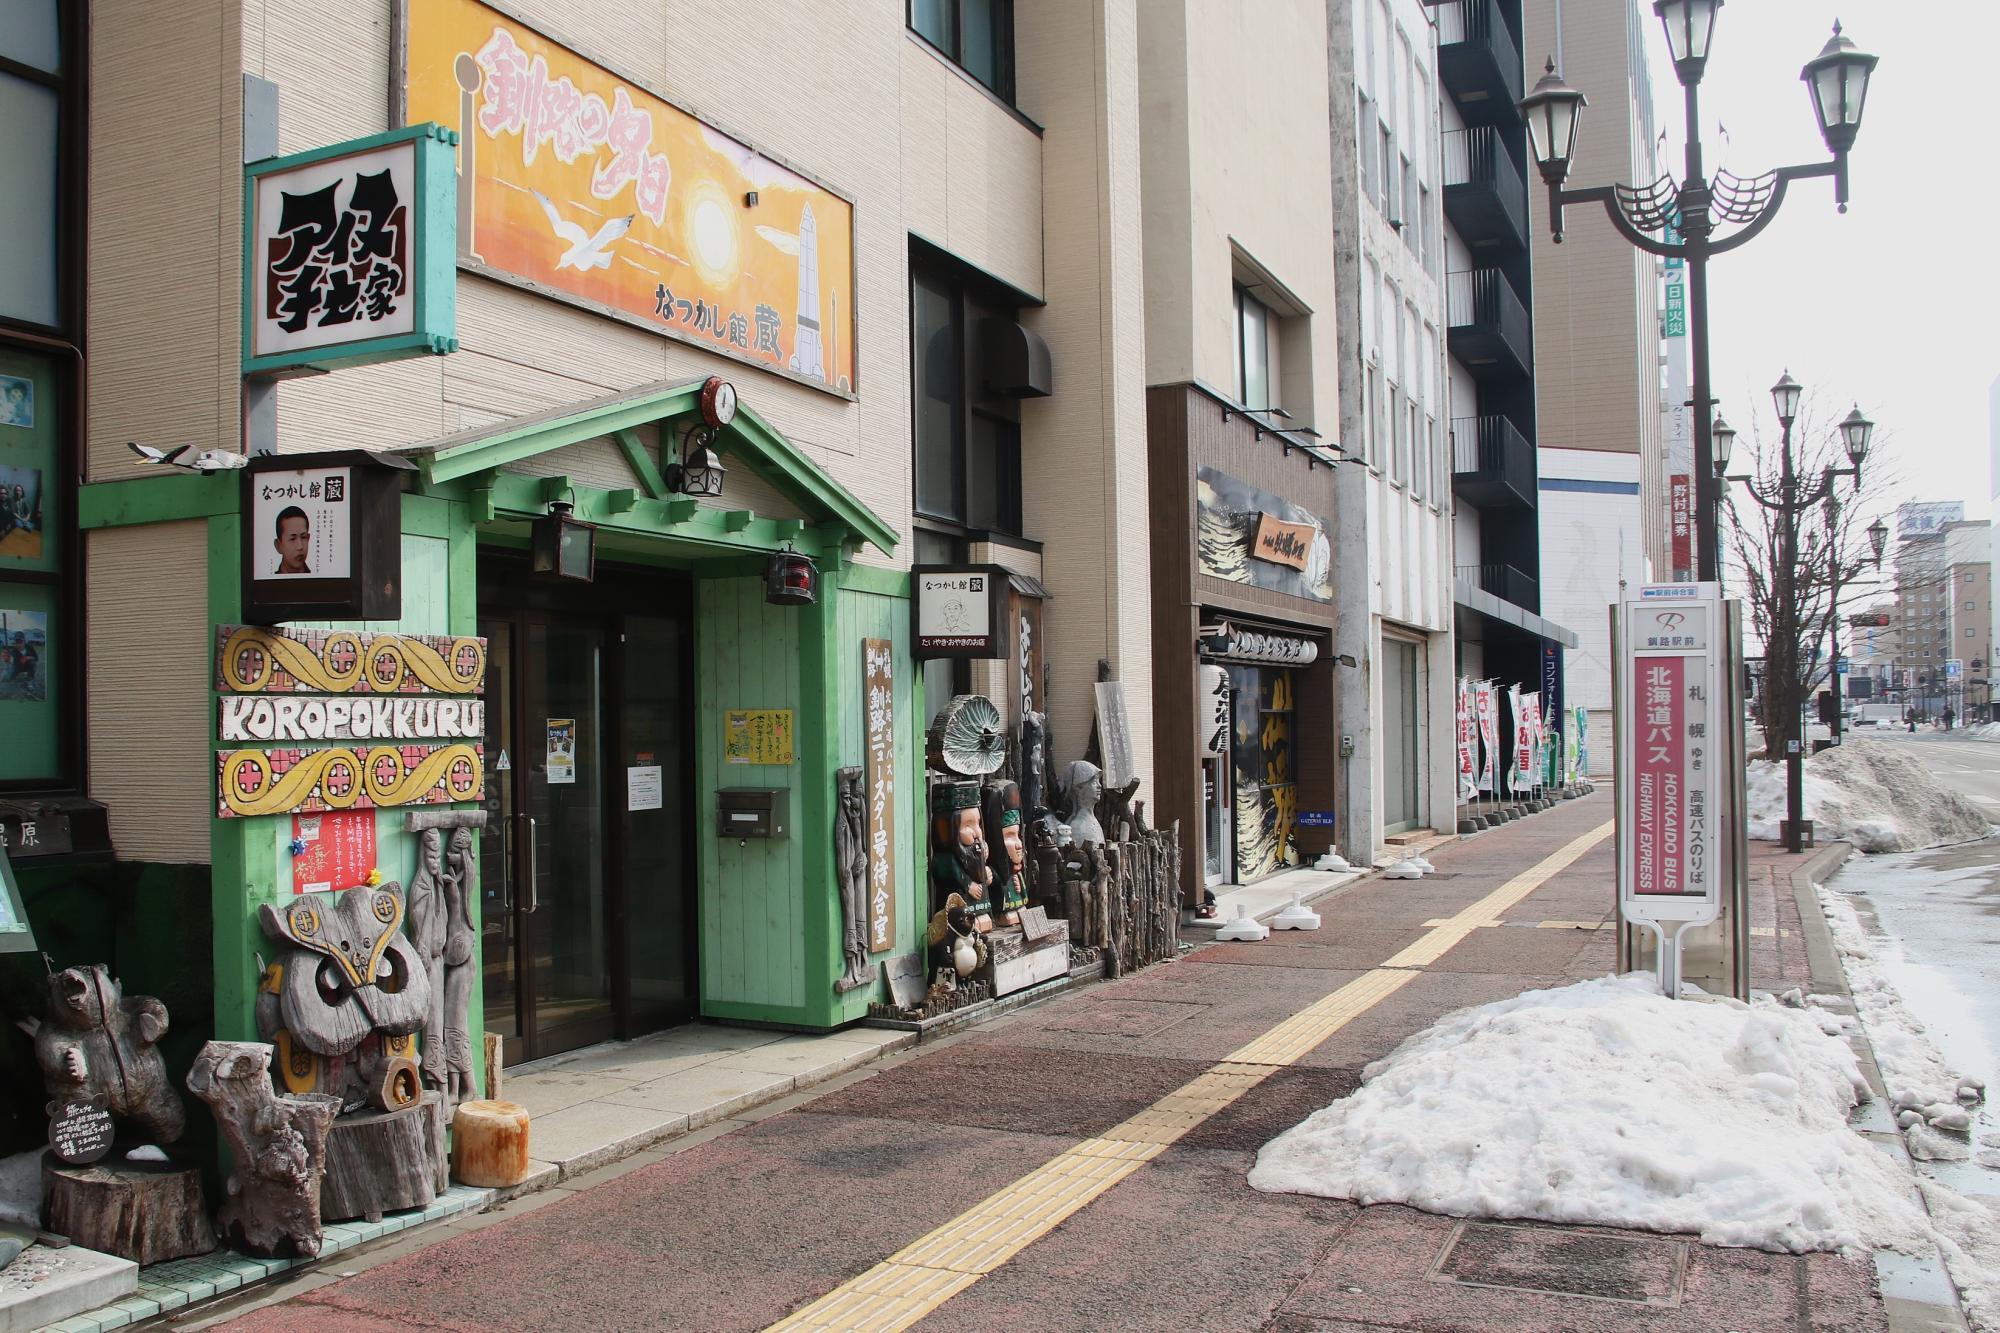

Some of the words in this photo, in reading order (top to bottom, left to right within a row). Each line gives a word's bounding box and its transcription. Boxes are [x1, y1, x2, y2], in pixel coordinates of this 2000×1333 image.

[1668, 286, 1682, 335] 日新火災
[262, 481, 322, 501] なつかし館
[326, 478, 343, 501] 蔵
[925, 580, 968, 591] なつかし館
[1647, 636, 1695, 647] 釧路駅前
[220, 696, 483, 741] KOROPOKKURU
[1646, 666, 1673, 764] 北海道バス
[1688, 685, 1705, 770] 札幌ゆき
[869, 685, 889, 945] 釧路ニュースター号待合室
[1640, 772, 1653, 831] HIGHWAY
[1664, 773, 1677, 854] HOKKAIDO
[1640, 832, 1653, 889] EXPRESS
[1690, 789, 1705, 884] 高速バスのりば
[1664, 858, 1677, 889] BUS
